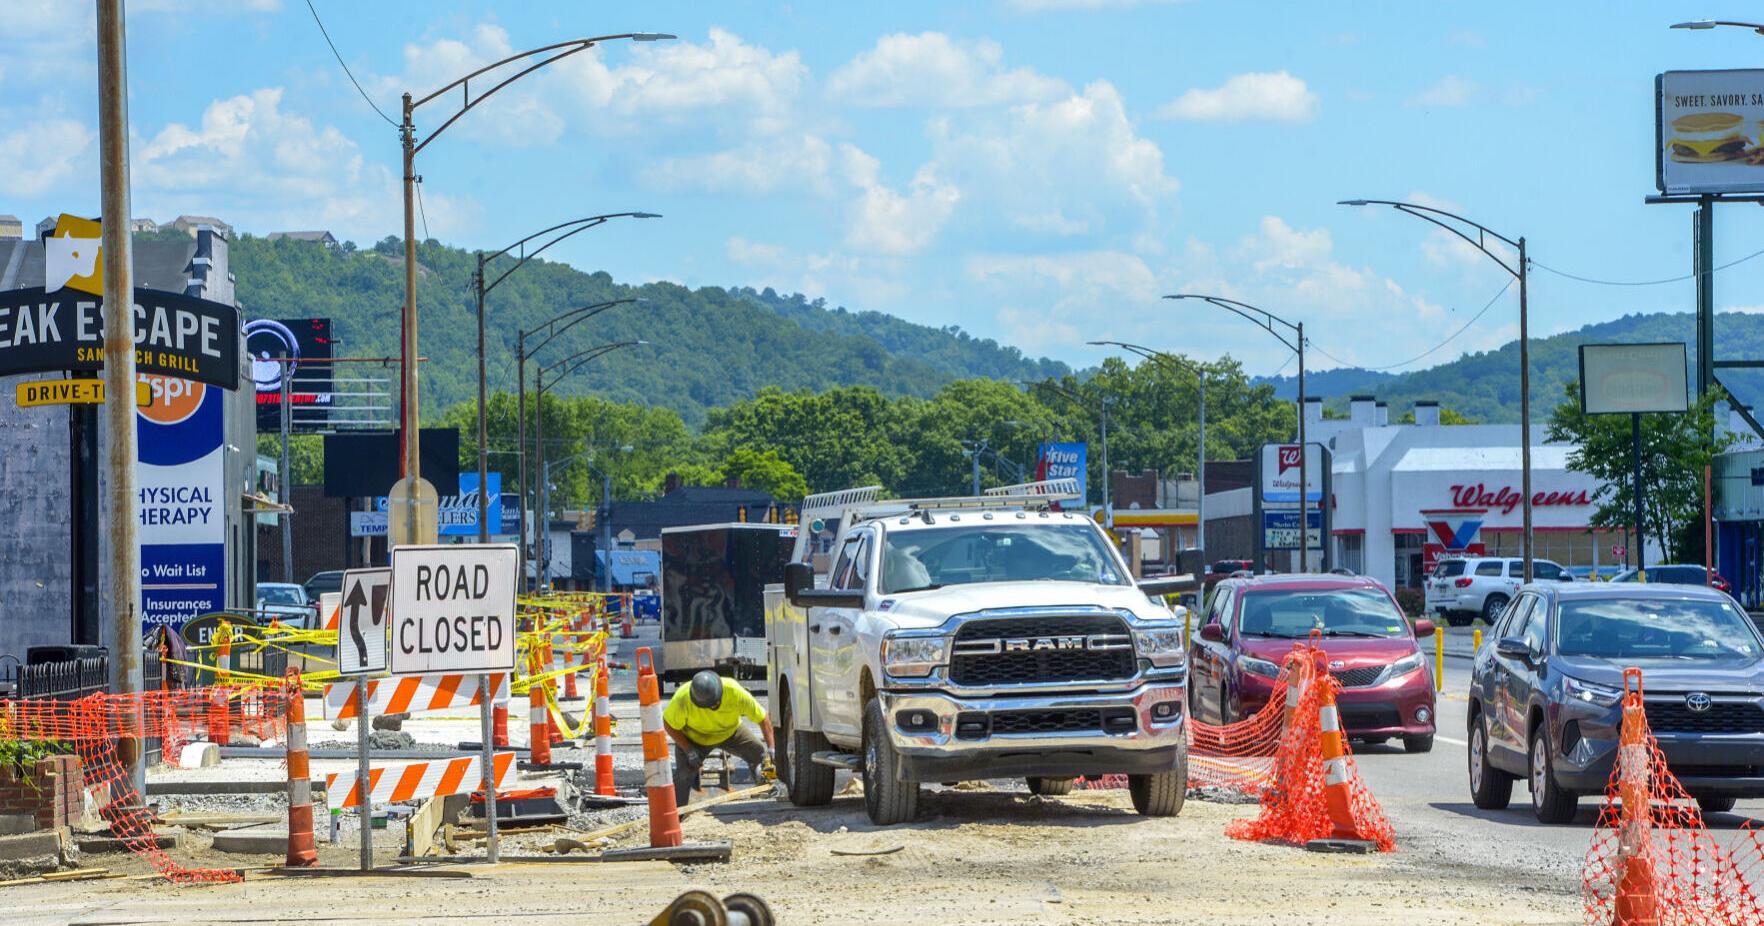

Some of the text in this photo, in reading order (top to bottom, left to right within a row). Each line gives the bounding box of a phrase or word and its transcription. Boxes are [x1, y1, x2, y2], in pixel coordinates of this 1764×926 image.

[1675, 95, 1707, 108] SWEET.
[1710, 94, 1748, 107] SAVORY.
[76, 301, 221, 358] ECAPE
[77, 347, 200, 373] SANCH GRILL
[27, 384, 105, 402] DRIVE-T
[1052, 451, 1078, 463] Five
[1049, 464, 1078, 477] Star
[139, 486, 213, 504] HYSICAL
[1450, 483, 1592, 515] Walgeens
[139, 506, 212, 525] HERAPY
[153, 564, 183, 577] Wait
[186, 564, 207, 577] List
[416, 564, 489, 601] ROAD
[146, 597, 212, 610] Insurances
[199, 626, 244, 643] ENR
[400, 615, 502, 654] CLOSED
[1006, 637, 1083, 651] RAM
